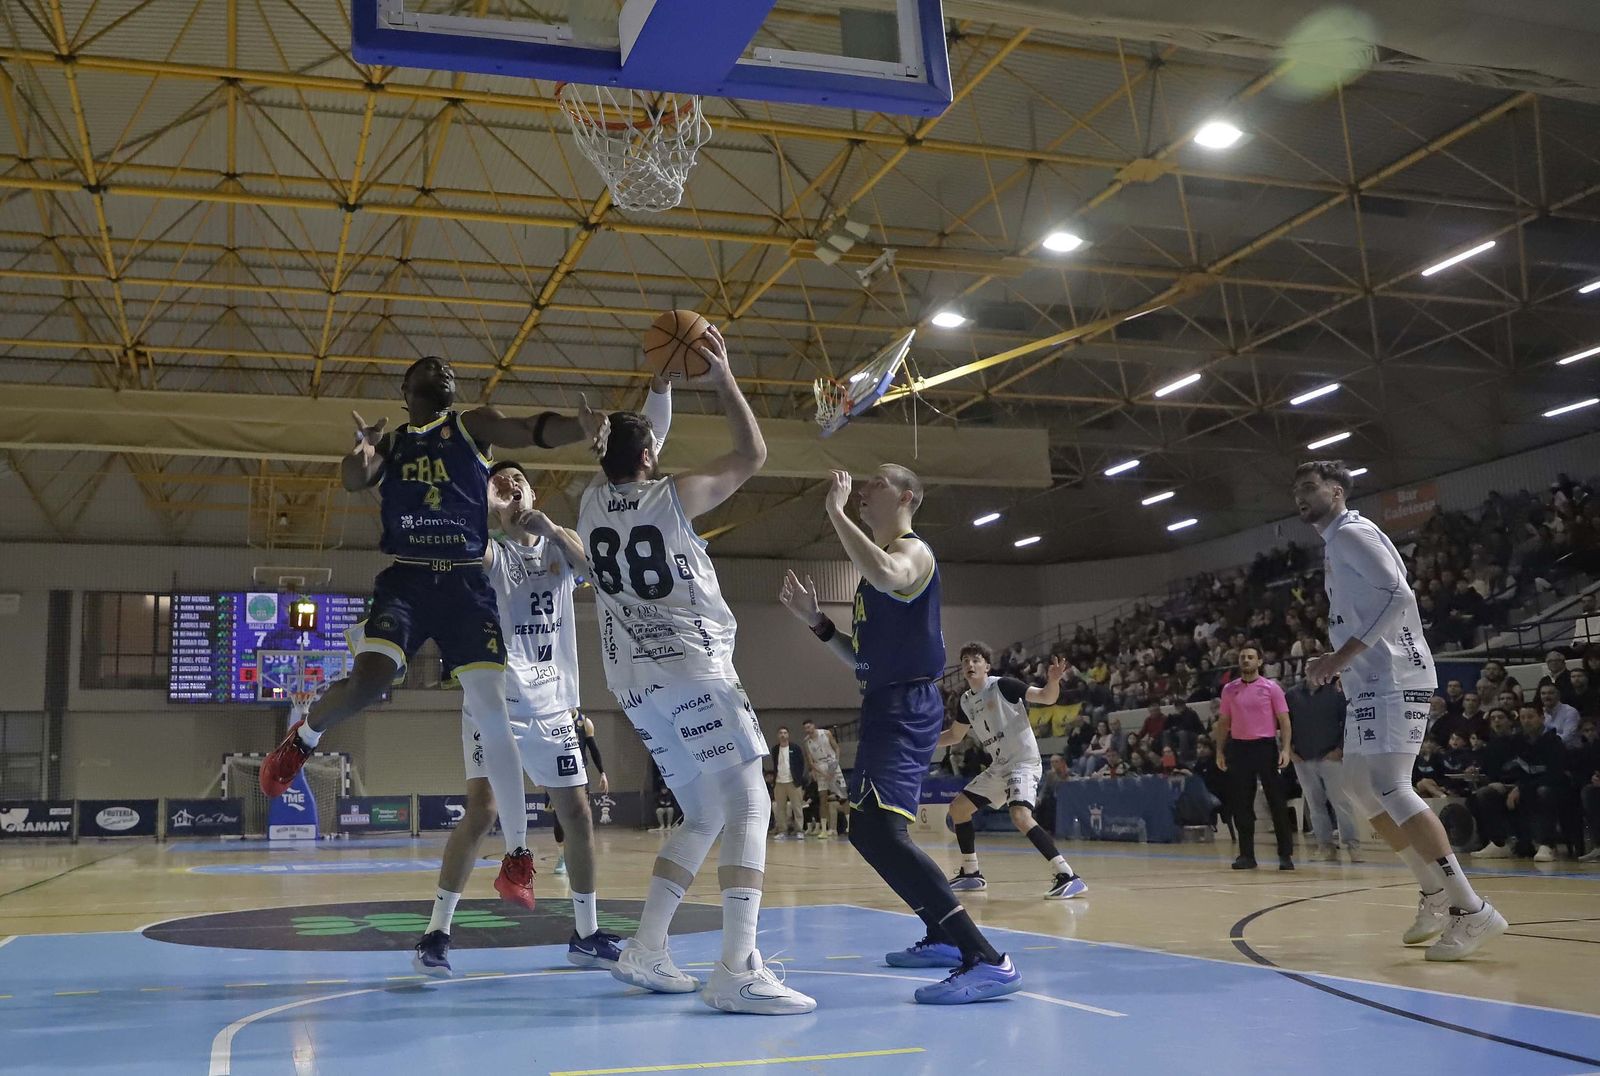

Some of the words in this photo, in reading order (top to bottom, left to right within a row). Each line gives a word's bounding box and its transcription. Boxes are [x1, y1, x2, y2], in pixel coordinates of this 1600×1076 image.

[424, 486, 441, 511] 4
[590, 525, 674, 600] 88
[530, 591, 554, 616] 23
[254, 632, 267, 648] 7
[487, 638, 498, 654] 4
[680, 718, 723, 738] Blanca
[561, 758, 575, 770] LZ
[281, 793, 305, 803] TME
